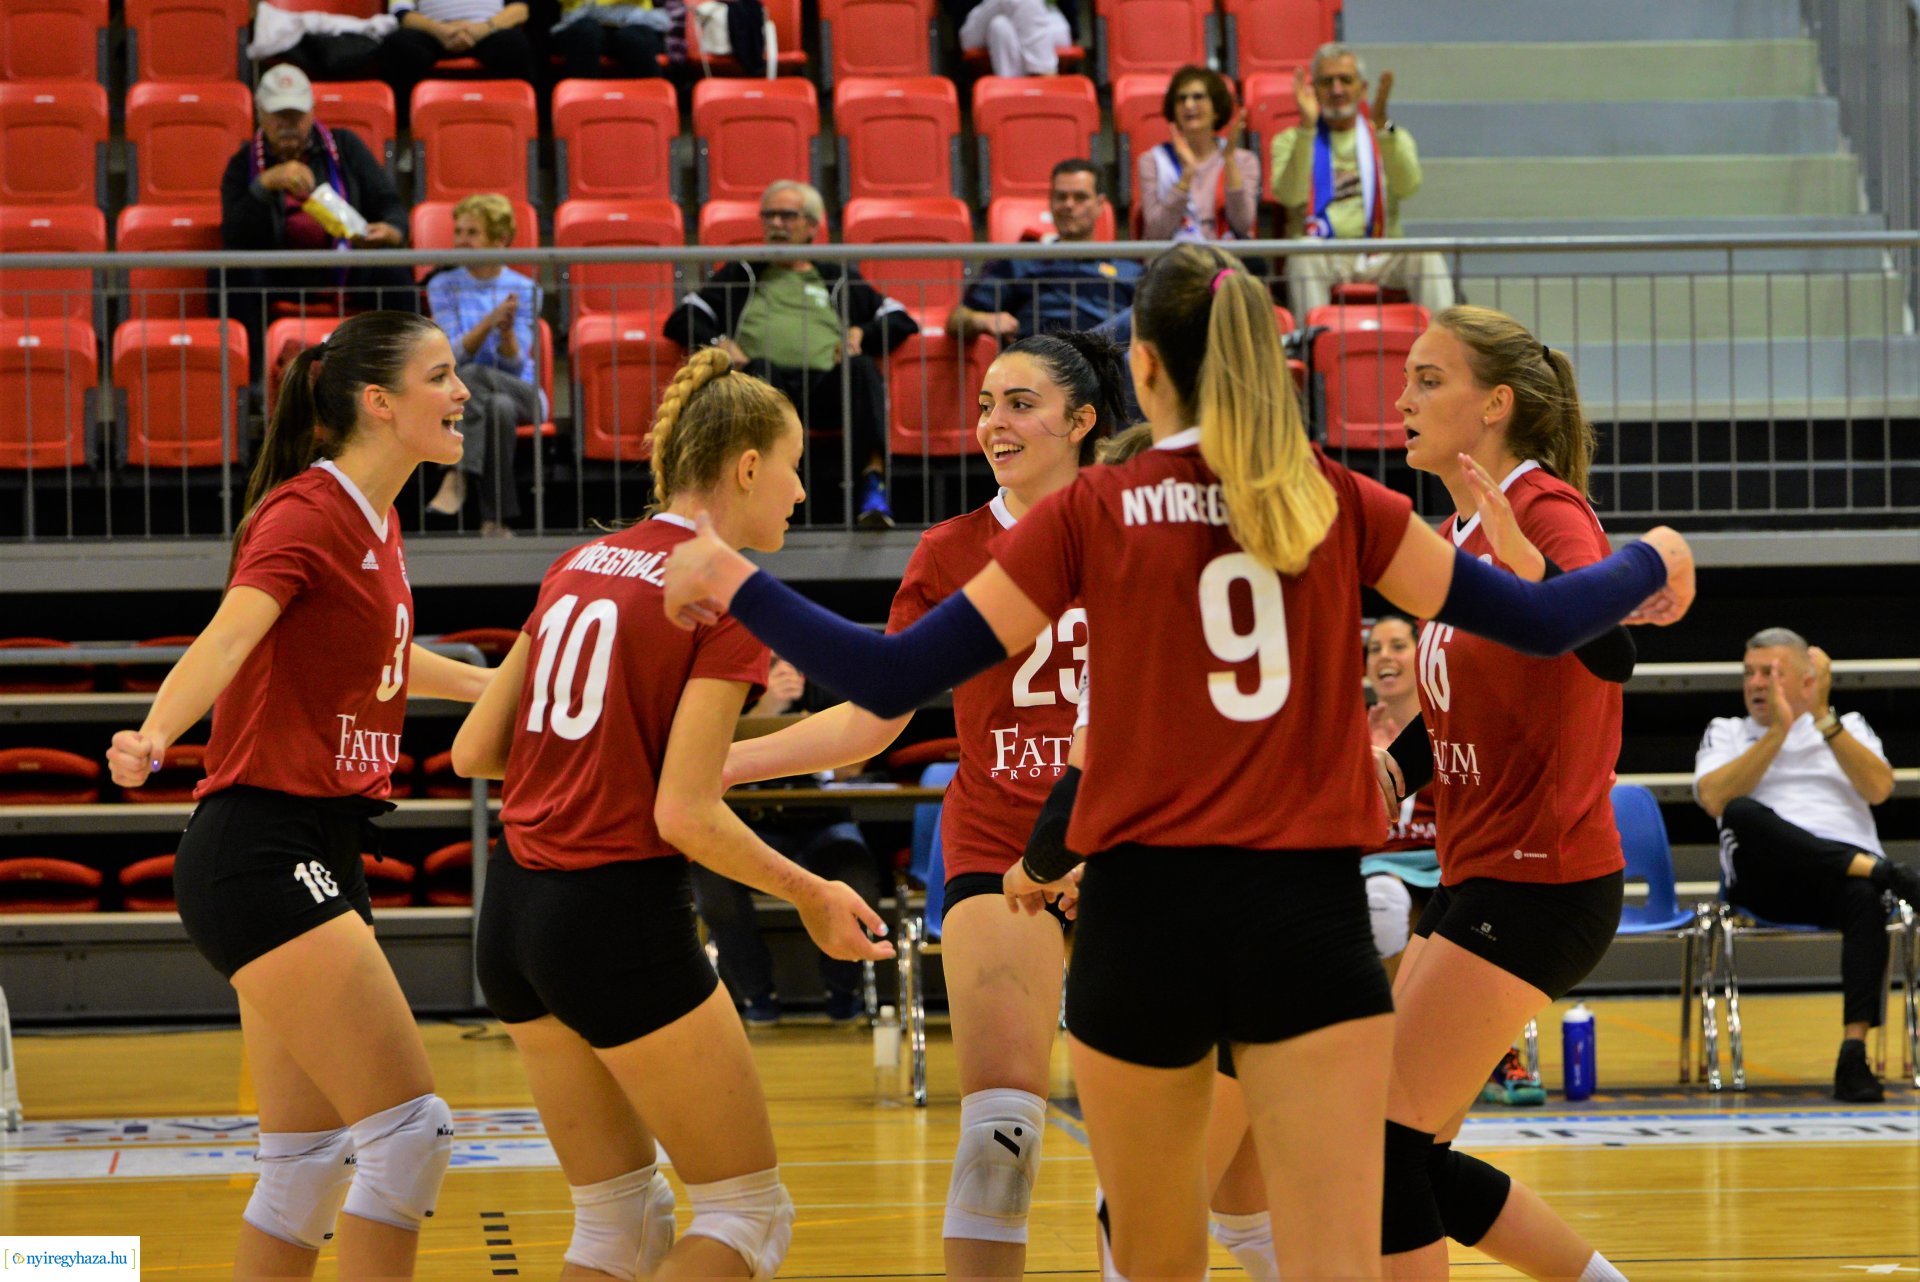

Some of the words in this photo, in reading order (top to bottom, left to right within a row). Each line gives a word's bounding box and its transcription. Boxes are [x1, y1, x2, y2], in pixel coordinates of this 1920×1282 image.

[376, 603, 409, 703] 3
[526, 593, 619, 741] 10
[1012, 607, 1089, 708] 23
[1198, 551, 1291, 722] 9
[1417, 620, 1454, 713] 16
